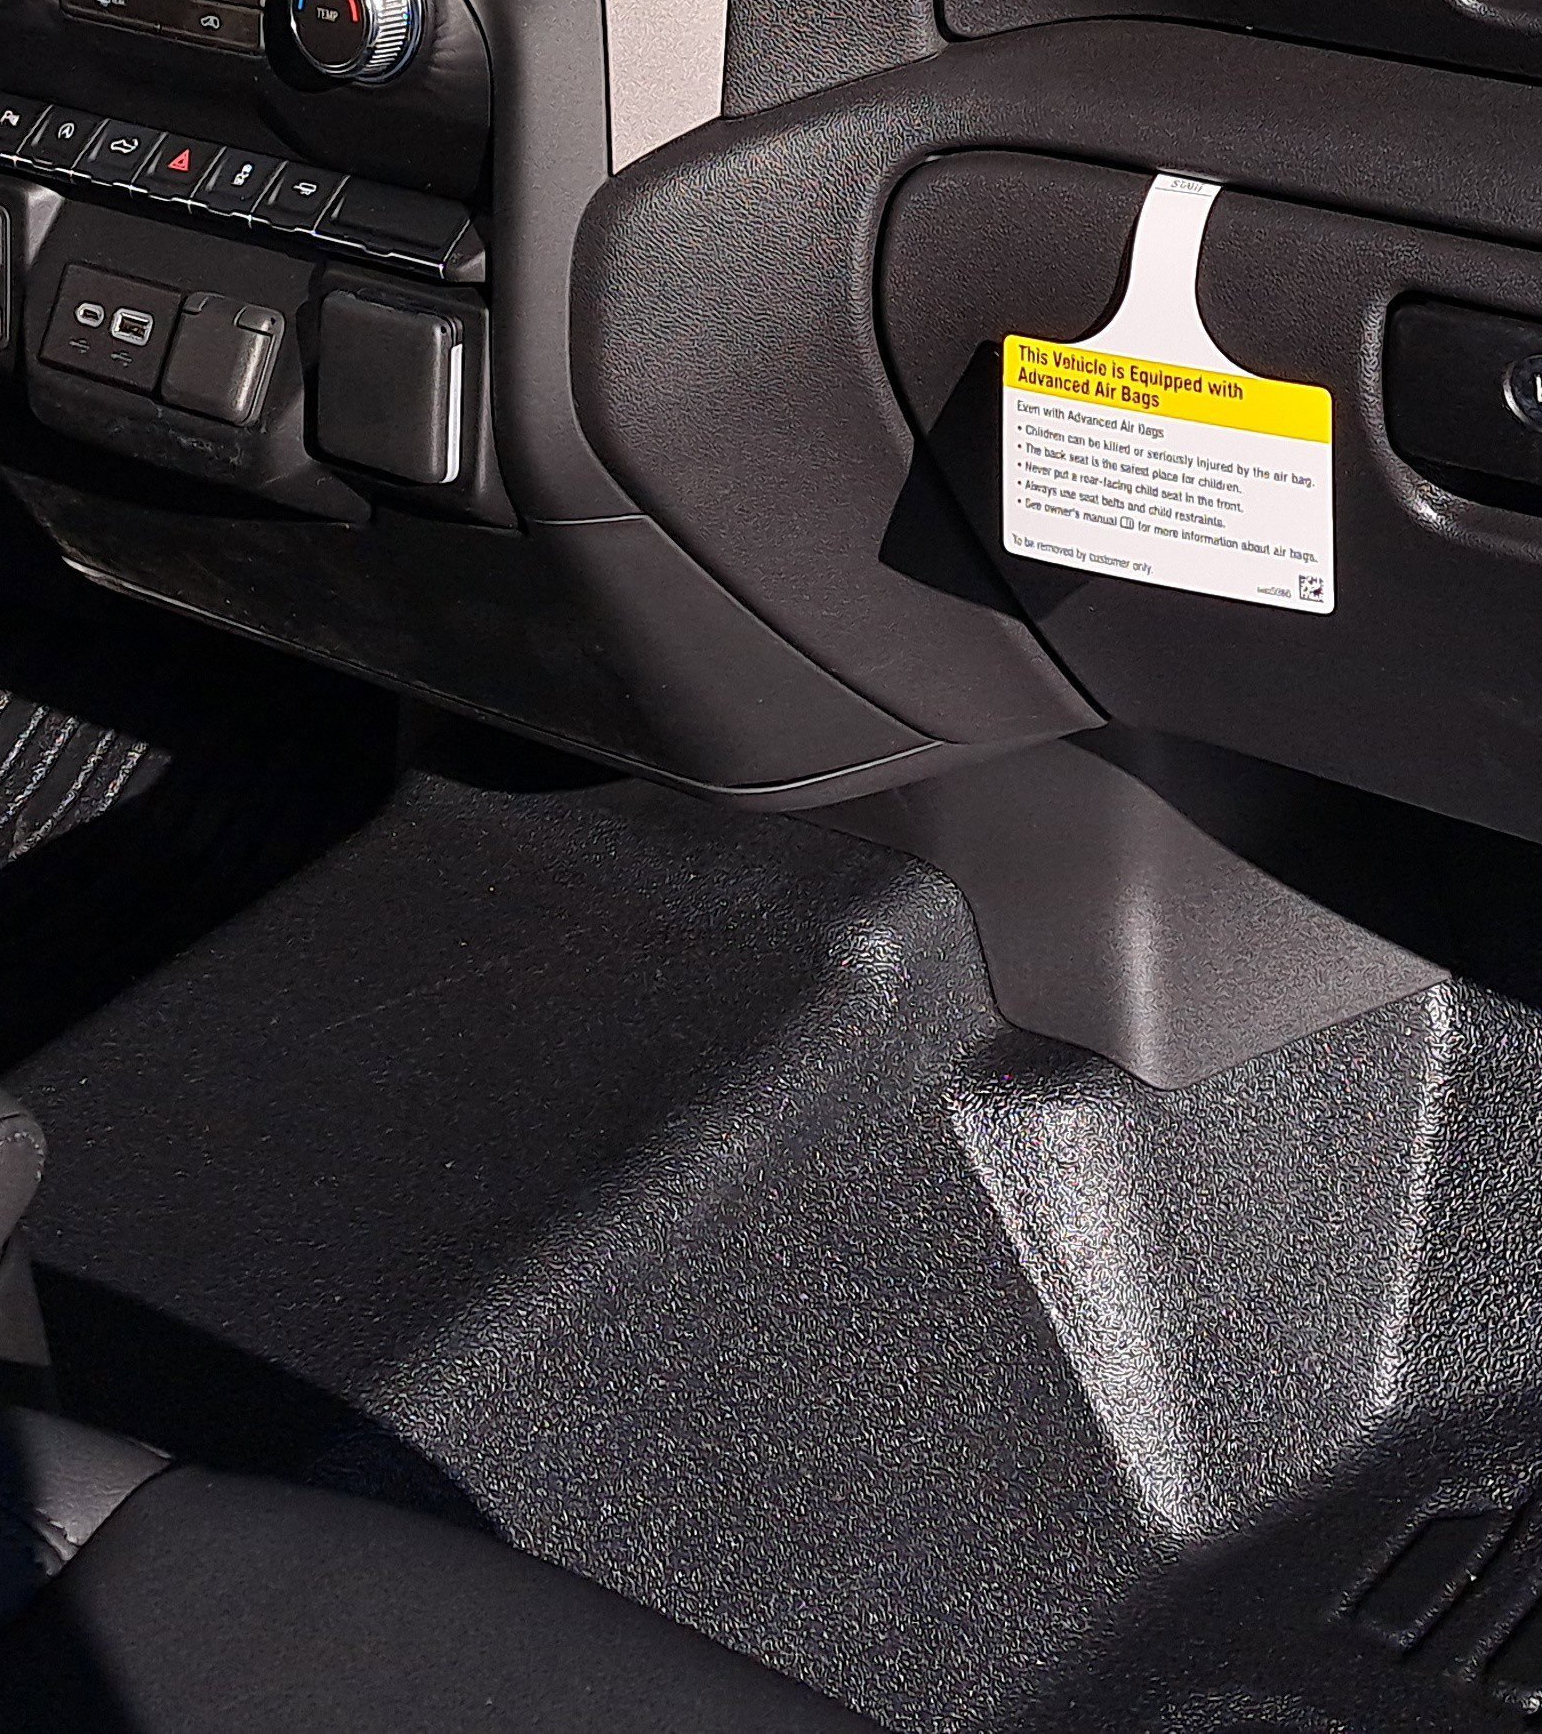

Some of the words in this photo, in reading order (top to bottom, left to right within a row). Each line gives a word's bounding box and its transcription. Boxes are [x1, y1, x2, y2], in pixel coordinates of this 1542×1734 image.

[316, 6, 339, 22] TEMP
[1018, 366, 1090, 395] Advanced
[1095, 381, 1117, 400] Air
[1121, 385, 1160, 409] Bags
[1019, 344, 1048, 366] This
[1053, 350, 1107, 376] Vehicle
[1112, 360, 1125, 379] is
[1130, 364, 1202, 393] Equipped
[1208, 380, 1243, 400] with
[1017, 399, 1040, 415] Even
[1043, 407, 1065, 420] with
[1068, 410, 1118, 431] Advanced
[1120, 419, 1135, 433] Air
[1138, 422, 1165, 439] Bags
[1025, 424, 1065, 443] Children
[1068, 433, 1086, 446] can
[1088, 437, 1100, 450] be
[1103, 439, 1131, 455] killed
[1133, 447, 1144, 457] or
[1147, 449, 1193, 468] seriously
[1197, 456, 1233, 474] injured
[1236, 463, 1250, 478] by
[1252, 466, 1270, 479] the
[1274, 471, 1288, 482] air
[1291, 472, 1315, 488] bag.
[1025, 442, 1041, 456] The
[1044, 446, 1066, 461] back
[1069, 453, 1089, 466] seat
[1091, 455, 1100, 468] is
[1102, 457, 1118, 471] the
[1120, 462, 1149, 477] safest
[1152, 469, 1178, 483] place
[1182, 473, 1195, 485] for
[1198, 477, 1243, 494] children.
[1025, 461, 1052, 476] Never
[1053, 469, 1069, 480] put
[1071, 472, 1078, 482] a
[1079, 474, 1132, 495] rear-facing
[1135, 483, 1159, 498] child
[1161, 490, 1183, 502] seat
[1185, 492, 1195, 504] in
[1197, 495, 1214, 508] the
[1216, 497, 1244, 513] front.
[1025, 479, 1058, 498] Always
[1059, 489, 1077, 500] use
[1079, 492, 1100, 505] seat
[1101, 495, 1125, 510] belts
[1127, 501, 1146, 514] and
[1148, 506, 1172, 519] child
[1174, 510, 1226, 529] restraints.
[1012, 532, 1023, 546] To
[1037, 541, 1074, 558] removed
[1076, 547, 1087, 563] by
[1089, 552, 1130, 569] customer
[1044, 504, 1080, 519] owner's
[1083, 512, 1117, 526] manual
[1138, 520, 1151, 533] for
[1154, 525, 1179, 539] more
[1181, 528, 1239, 550] information
[1241, 540, 1271, 555] about
[1273, 545, 1287, 557] air
